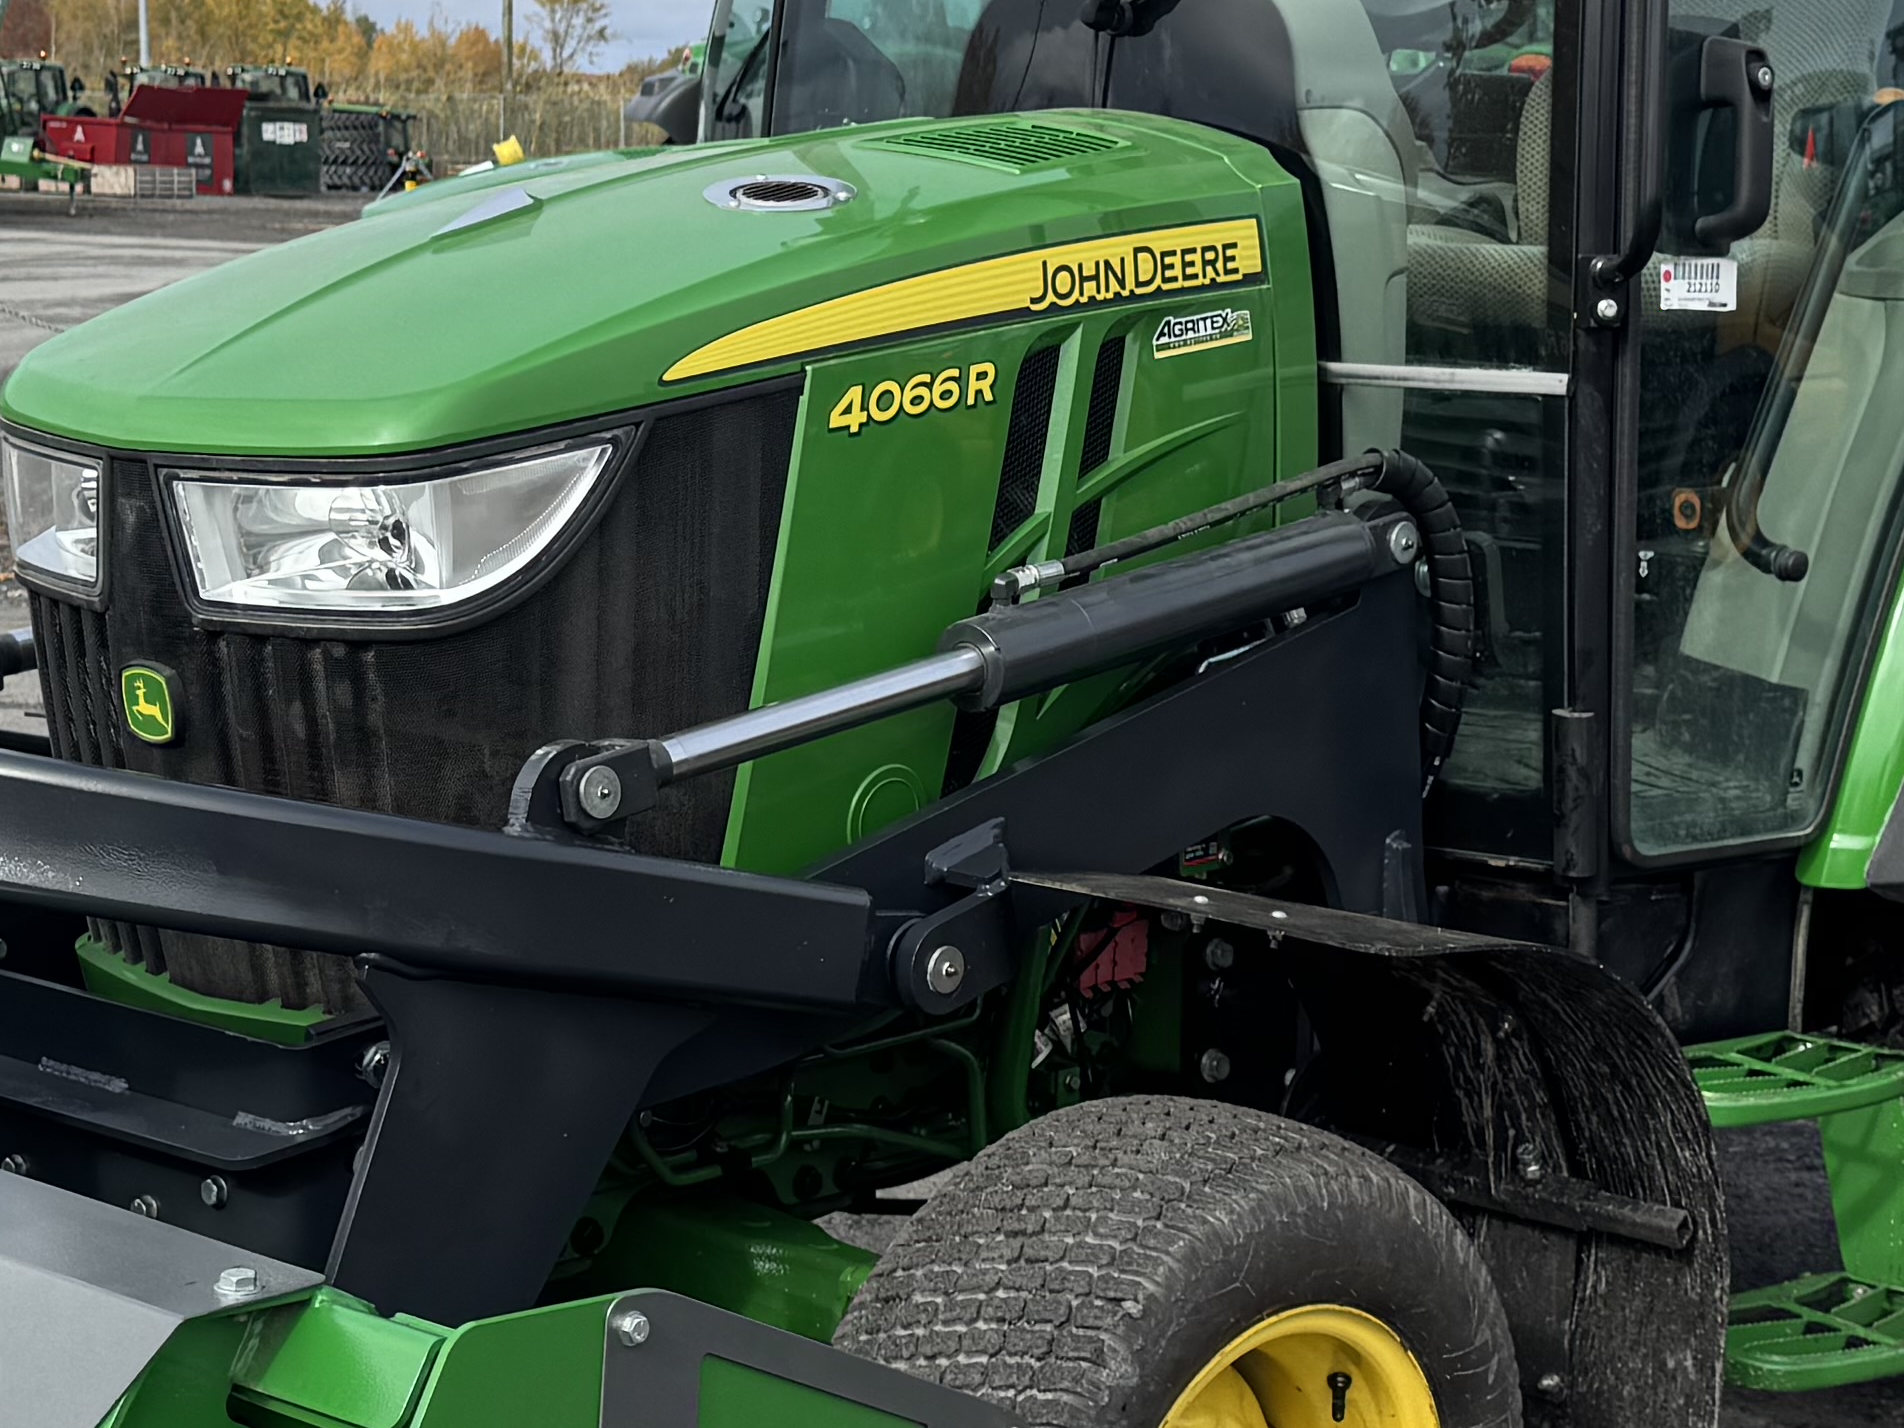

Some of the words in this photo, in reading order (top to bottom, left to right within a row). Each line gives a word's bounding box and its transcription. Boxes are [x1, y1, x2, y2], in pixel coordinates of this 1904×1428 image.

[1029, 257, 1126, 305] JOHN
[1132, 242, 1240, 289] DEERE
[1686, 281, 1720, 293] 212110
[1155, 311, 1231, 342] AGRITEX
